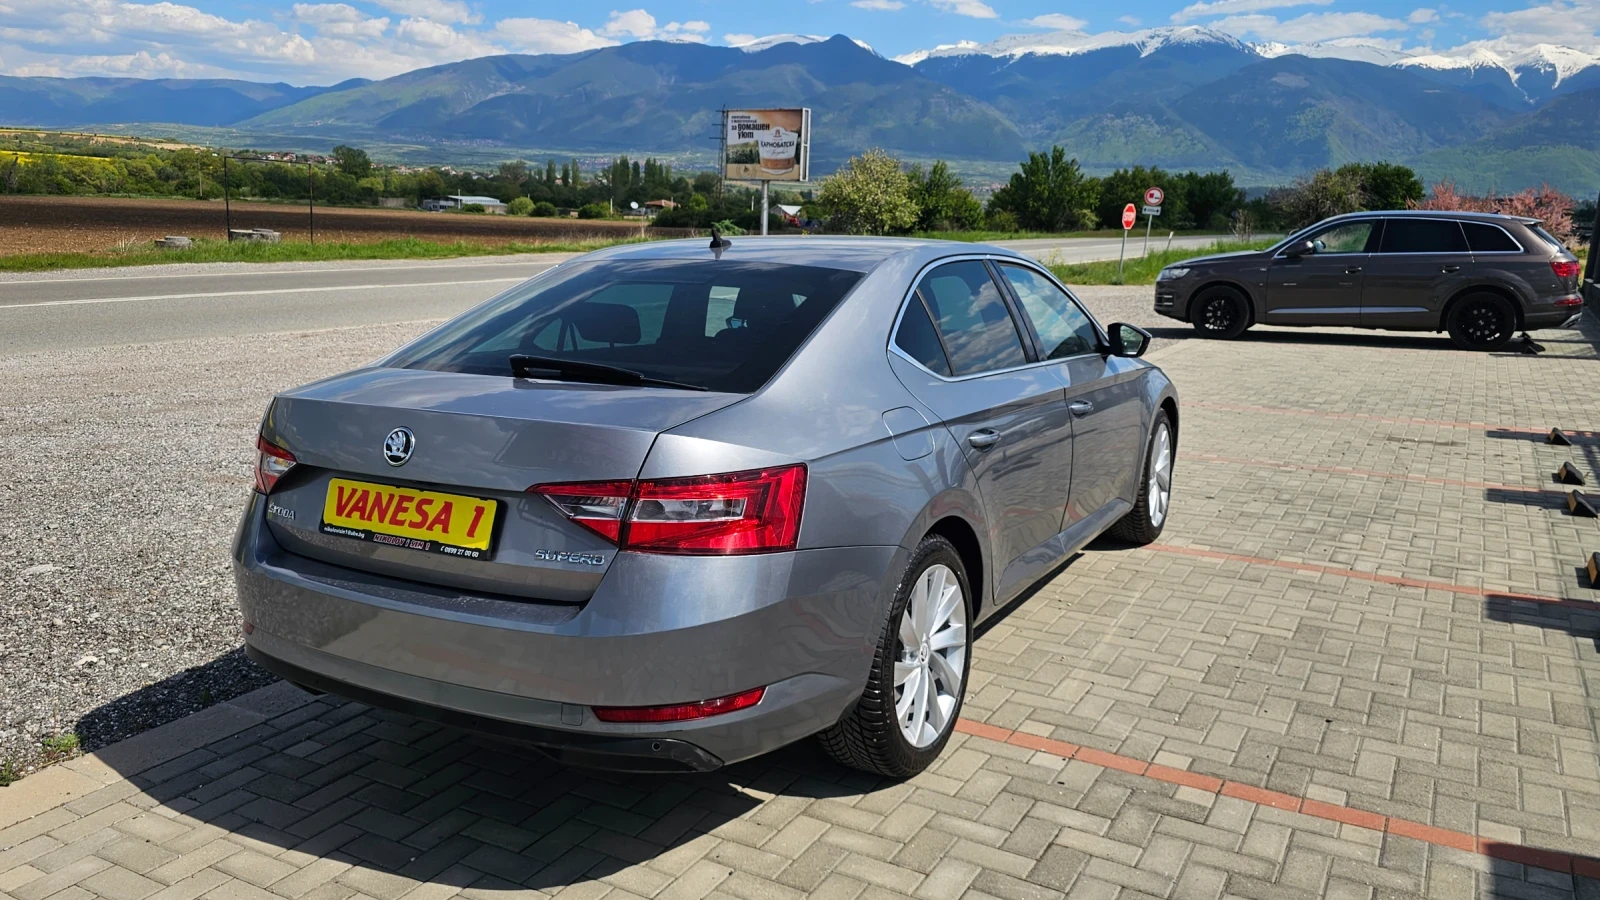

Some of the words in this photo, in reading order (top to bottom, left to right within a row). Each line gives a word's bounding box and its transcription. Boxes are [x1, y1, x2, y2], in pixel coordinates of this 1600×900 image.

[738, 123, 770, 132] домашен
[760, 140, 794, 148] КАРНОБАТСКА
[336, 486, 454, 534] VANESA
[466, 505, 485, 538] 1
[372, 534, 406, 546] NIKOLOV
